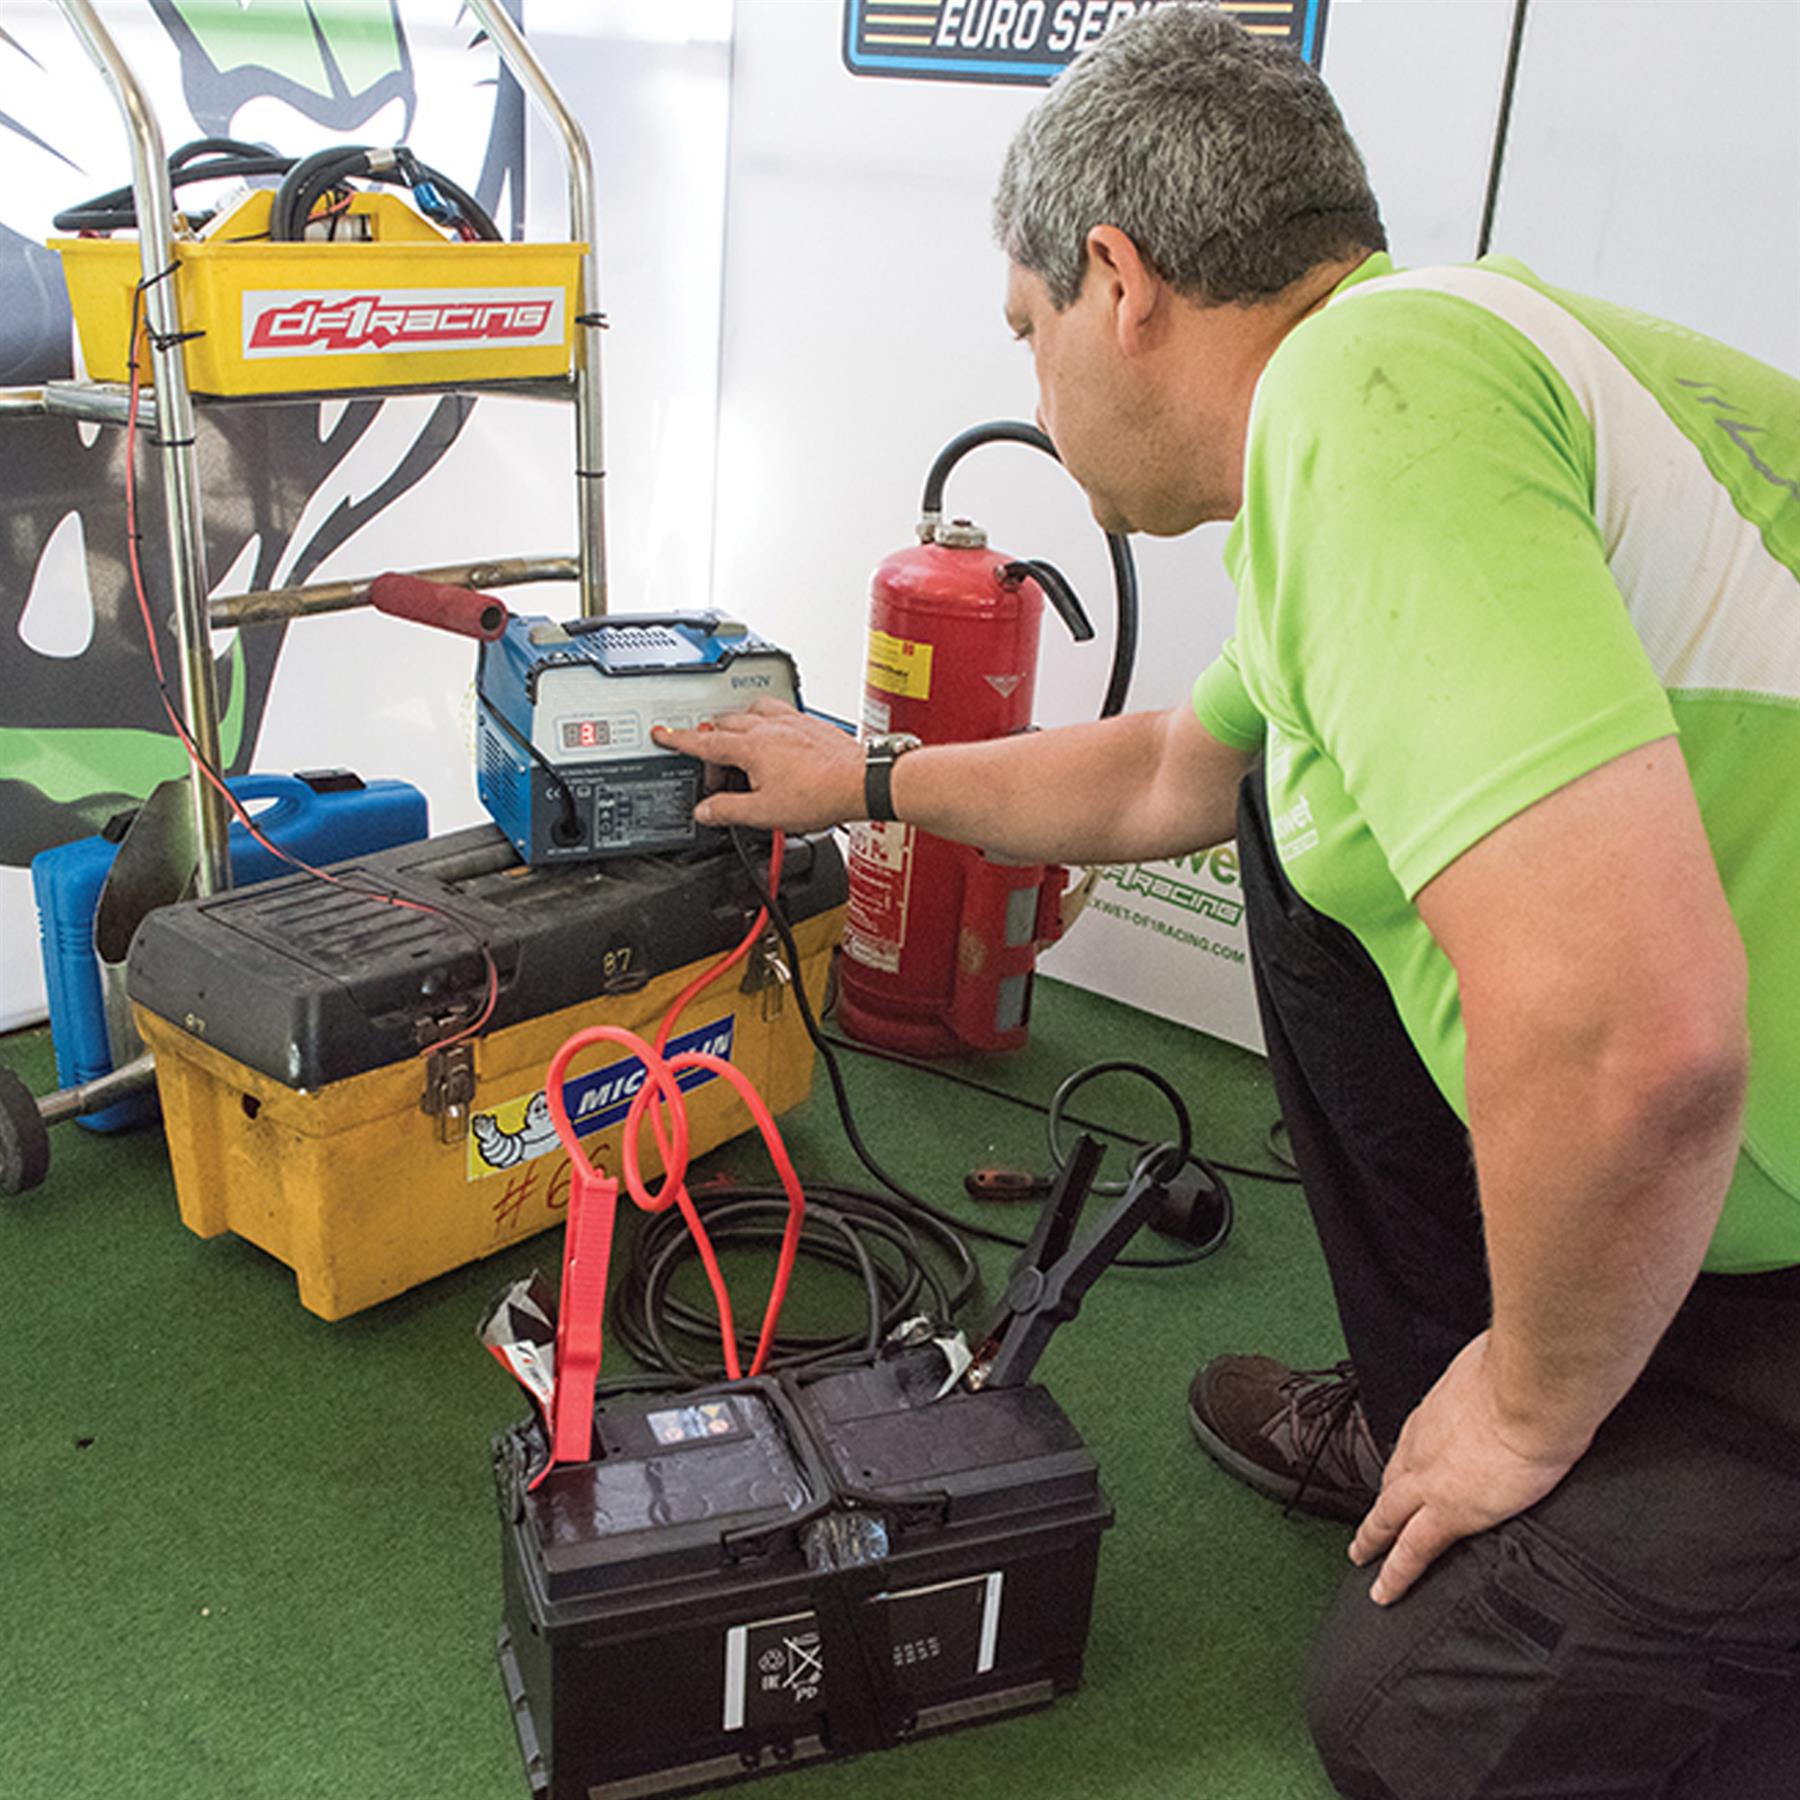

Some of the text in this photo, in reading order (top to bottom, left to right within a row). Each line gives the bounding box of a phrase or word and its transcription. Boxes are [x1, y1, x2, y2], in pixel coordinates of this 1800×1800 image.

[935, 0, 1204, 51] EURO SER
[603, 947, 631, 976] 87
[577, 1031, 732, 1115] MICIN
